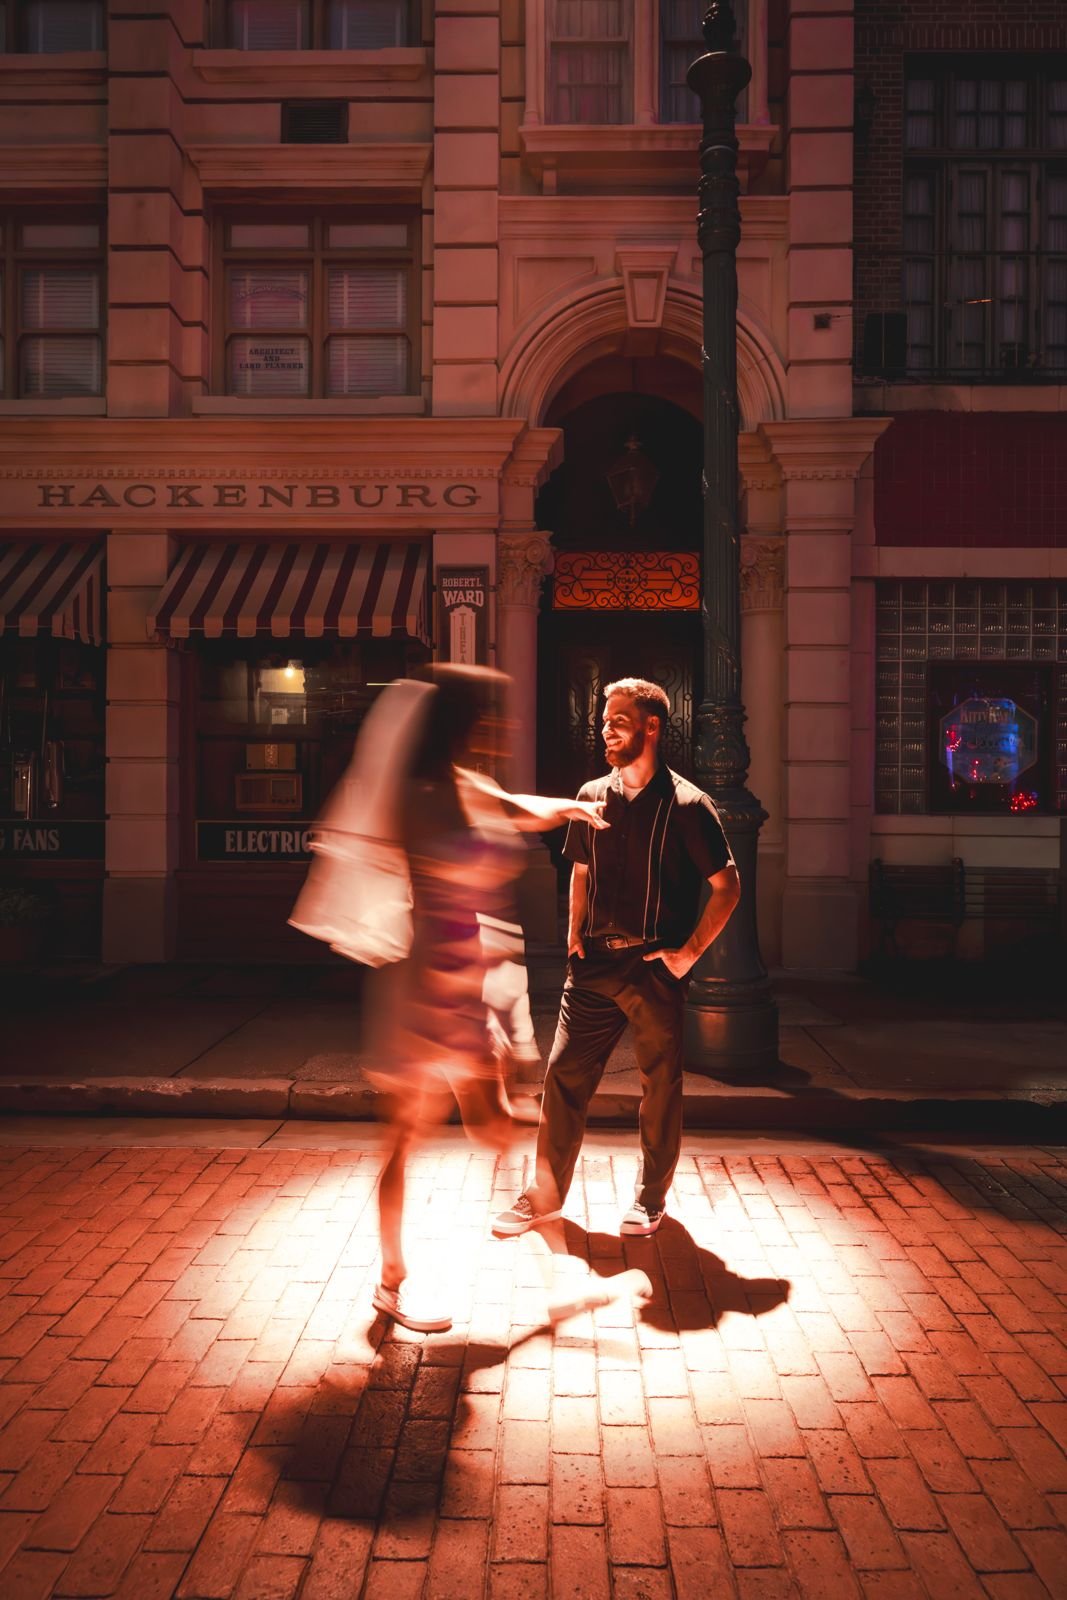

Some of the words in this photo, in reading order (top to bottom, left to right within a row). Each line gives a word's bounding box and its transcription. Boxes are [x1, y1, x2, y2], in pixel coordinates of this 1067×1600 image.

[38, 484, 481, 508] HACKENBURG
[442, 577, 475, 587] ROBERT
[443, 591, 485, 608] WARD
[13, 829, 60, 851] FANS
[225, 830, 313, 852] ELECTRIC
